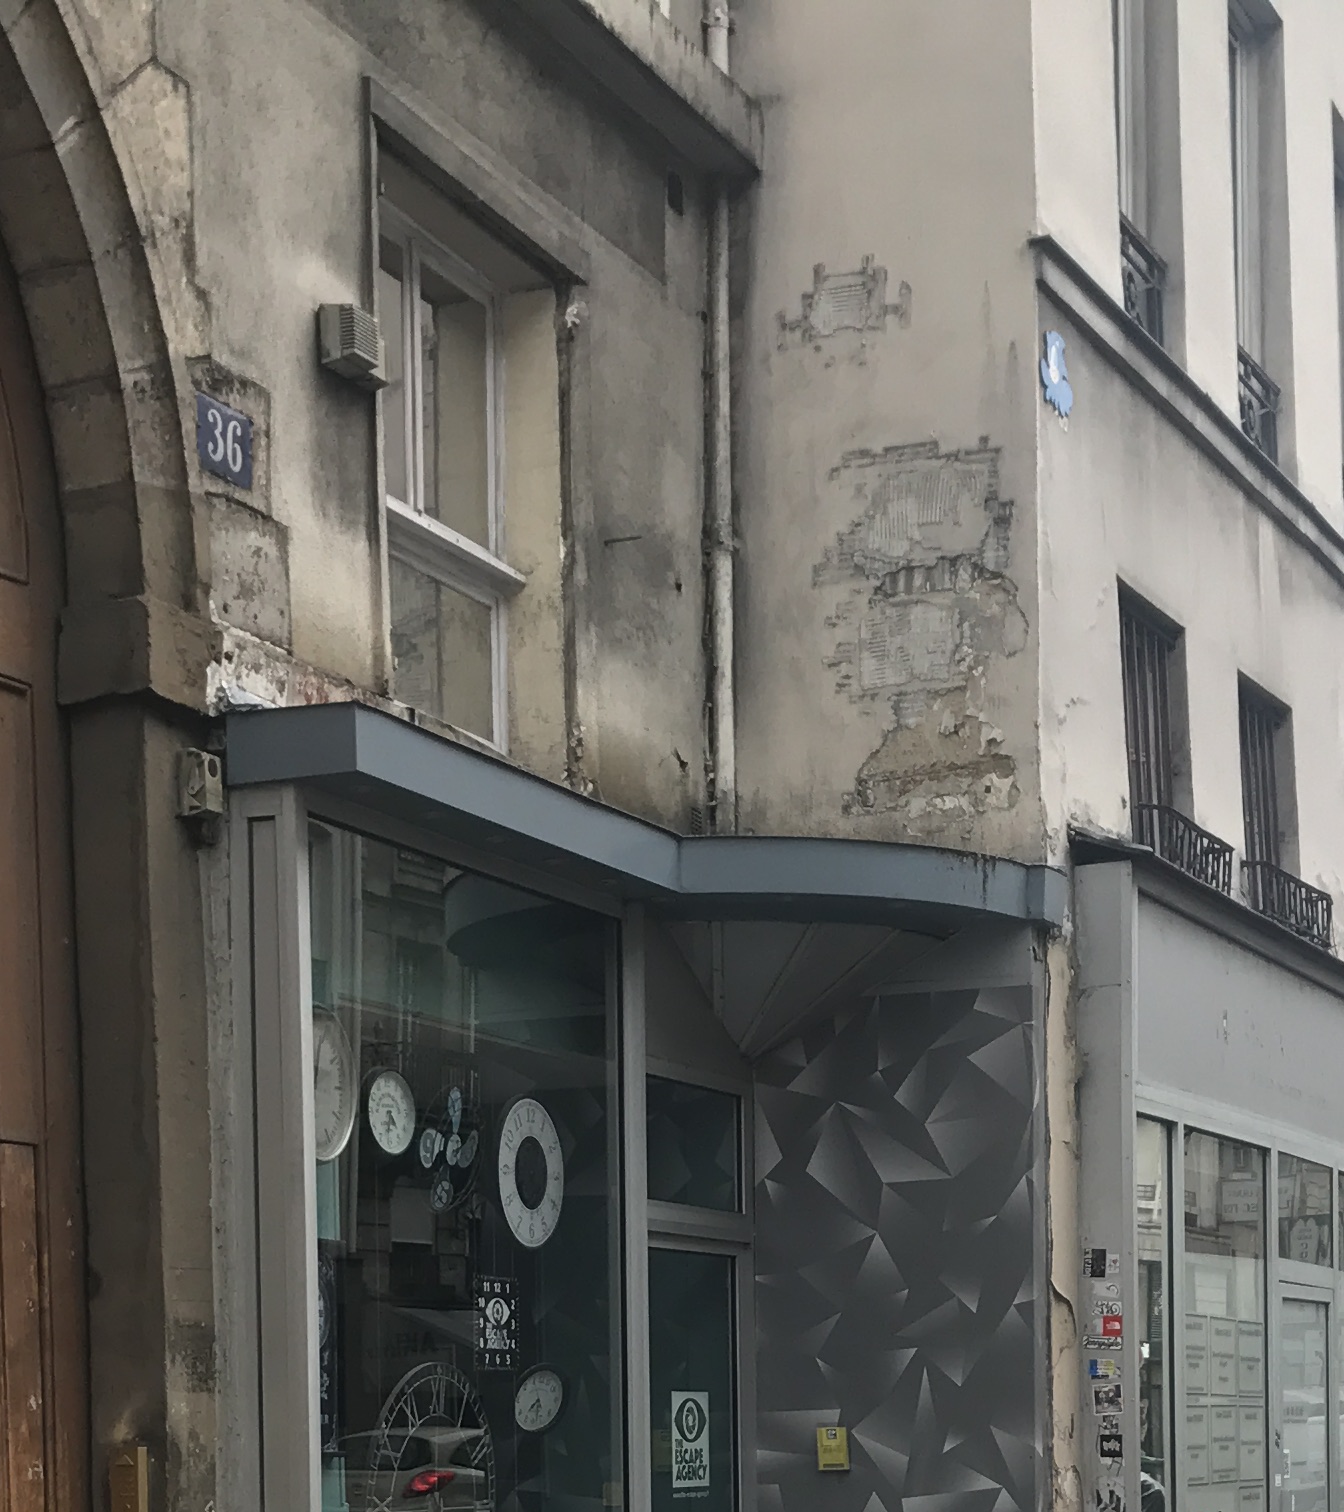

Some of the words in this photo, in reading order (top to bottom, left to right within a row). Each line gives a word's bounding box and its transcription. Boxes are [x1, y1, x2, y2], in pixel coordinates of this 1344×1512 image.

[207, 1408, 243, 1473] 36
[675, 1448, 704, 1465] ESCAPE
[675, 1464, 707, 1481] AGENCY
